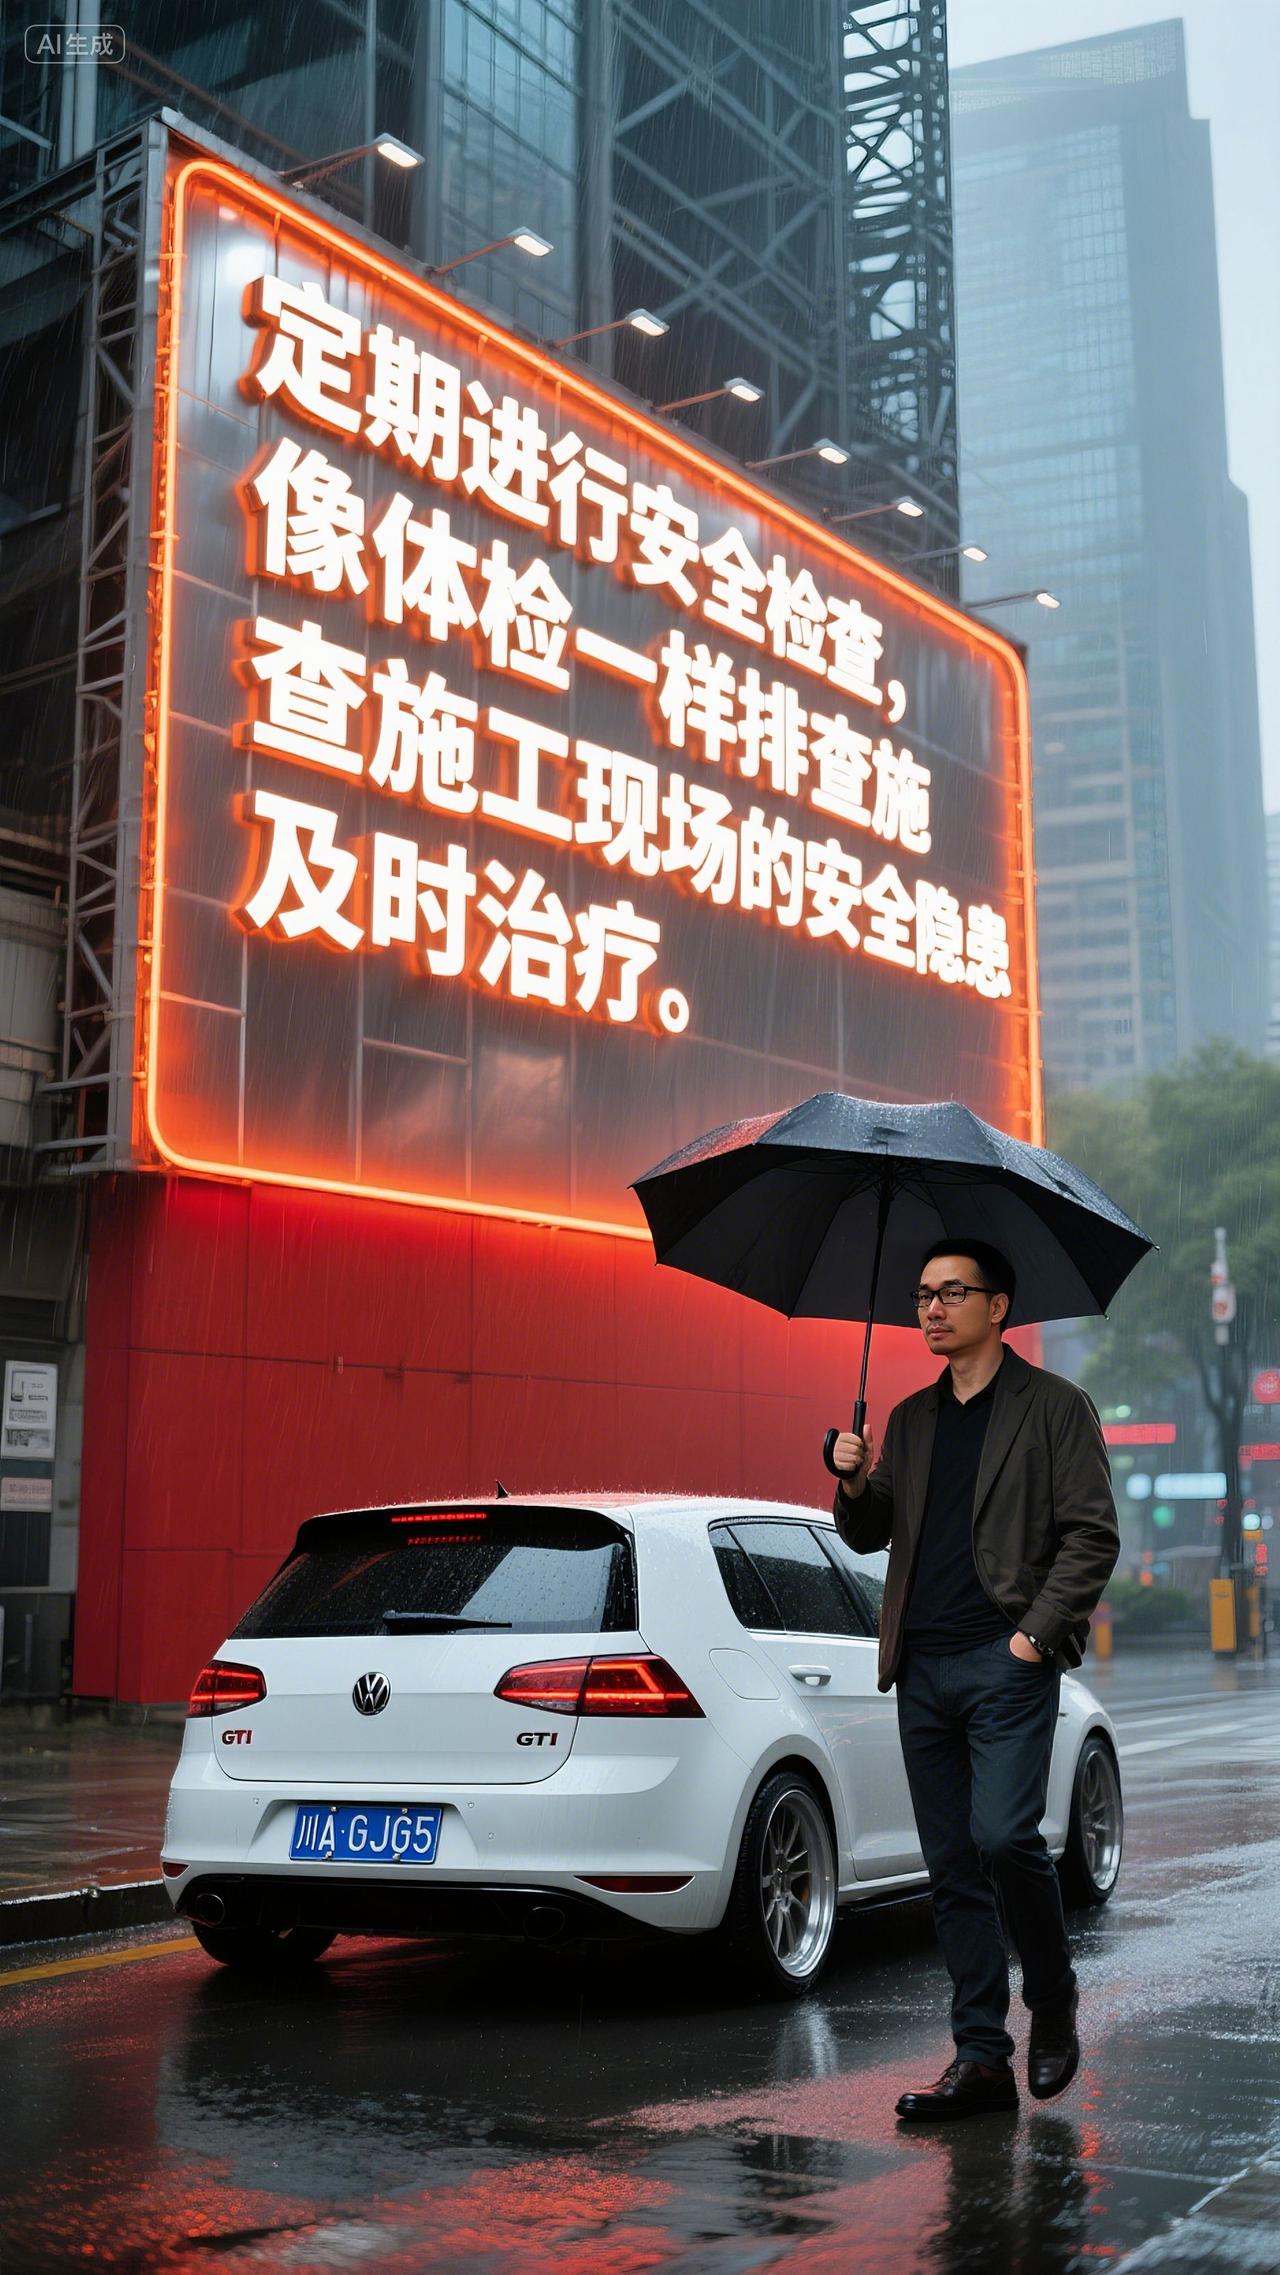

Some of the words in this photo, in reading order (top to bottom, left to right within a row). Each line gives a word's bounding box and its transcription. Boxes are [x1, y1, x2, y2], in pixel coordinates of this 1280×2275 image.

[253, 436, 933, 855] 像体检一样排查施
[255, 274, 907, 724] 定期进行安全检查，
[244, 789, 691, 1034] 及时治疗。
[250, 615, 1013, 999] 查施工现场的安全隐患
[221, 1729, 253, 1746] GTI
[516, 1732, 559, 1747] GTI
